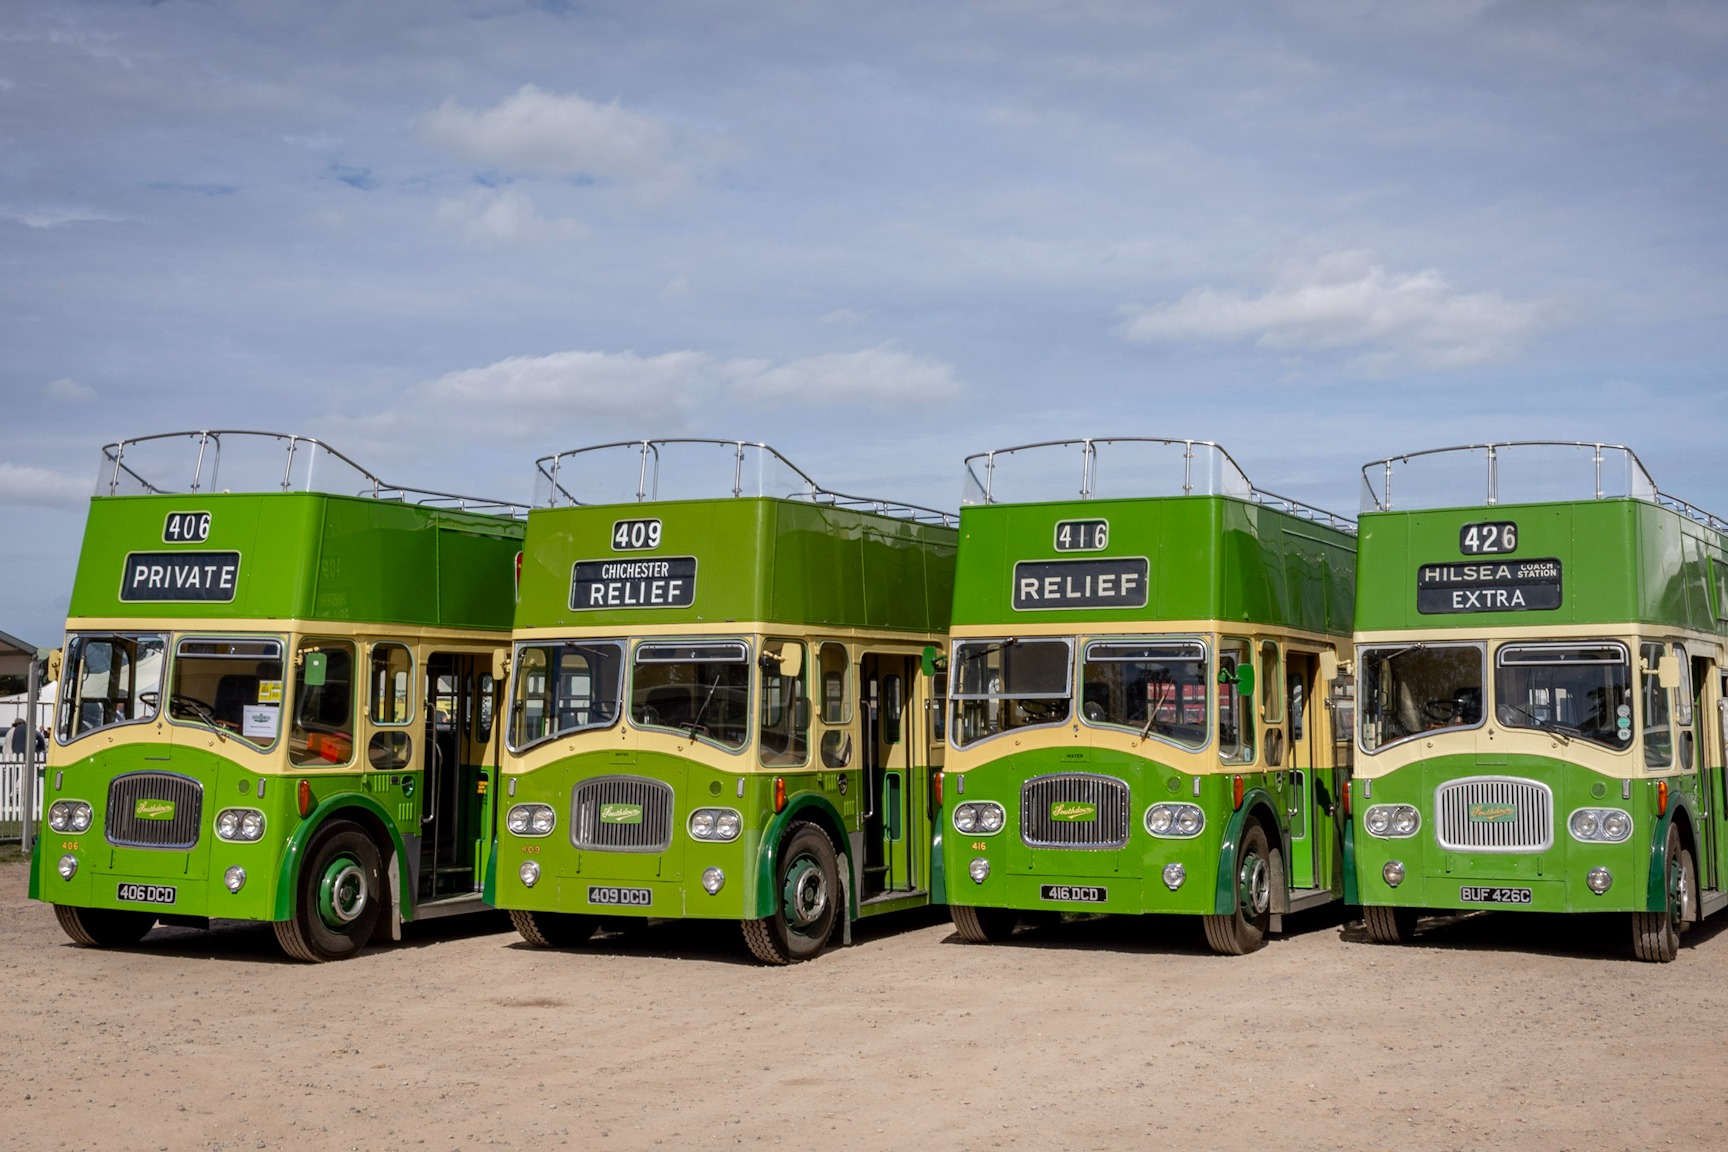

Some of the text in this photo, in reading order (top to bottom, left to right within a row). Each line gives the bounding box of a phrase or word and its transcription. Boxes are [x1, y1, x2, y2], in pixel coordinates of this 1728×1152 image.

[169, 514, 210, 539] 406
[615, 522, 661, 548] 409
[1059, 524, 1106, 548] 416
[1464, 525, 1516, 552] 426
[132, 565, 235, 589] PRIVATE
[601, 562, 670, 579] CHICHESTER
[1425, 565, 1557, 582] HILSEA STATION
[589, 580, 683, 606] RELIEF
[1020, 573, 1139, 601] RELIEF
[1452, 589, 1526, 609] EXTRA
[137, 801, 173, 817] Southdown
[601, 806, 641, 821] Southdown
[1052, 804, 1094, 819] Southdown
[1471, 805, 1514, 820] Southdown
[62, 841, 79, 850] 406
[521, 844, 541, 855] 409
[972, 842, 986, 851] 416
[120, 885, 174, 903] 406 DCD
[591, 888, 649, 904] 409 DCD
[1049, 887, 1099, 901] 416 DCD
[1462, 888, 1531, 903] BUF 426C
